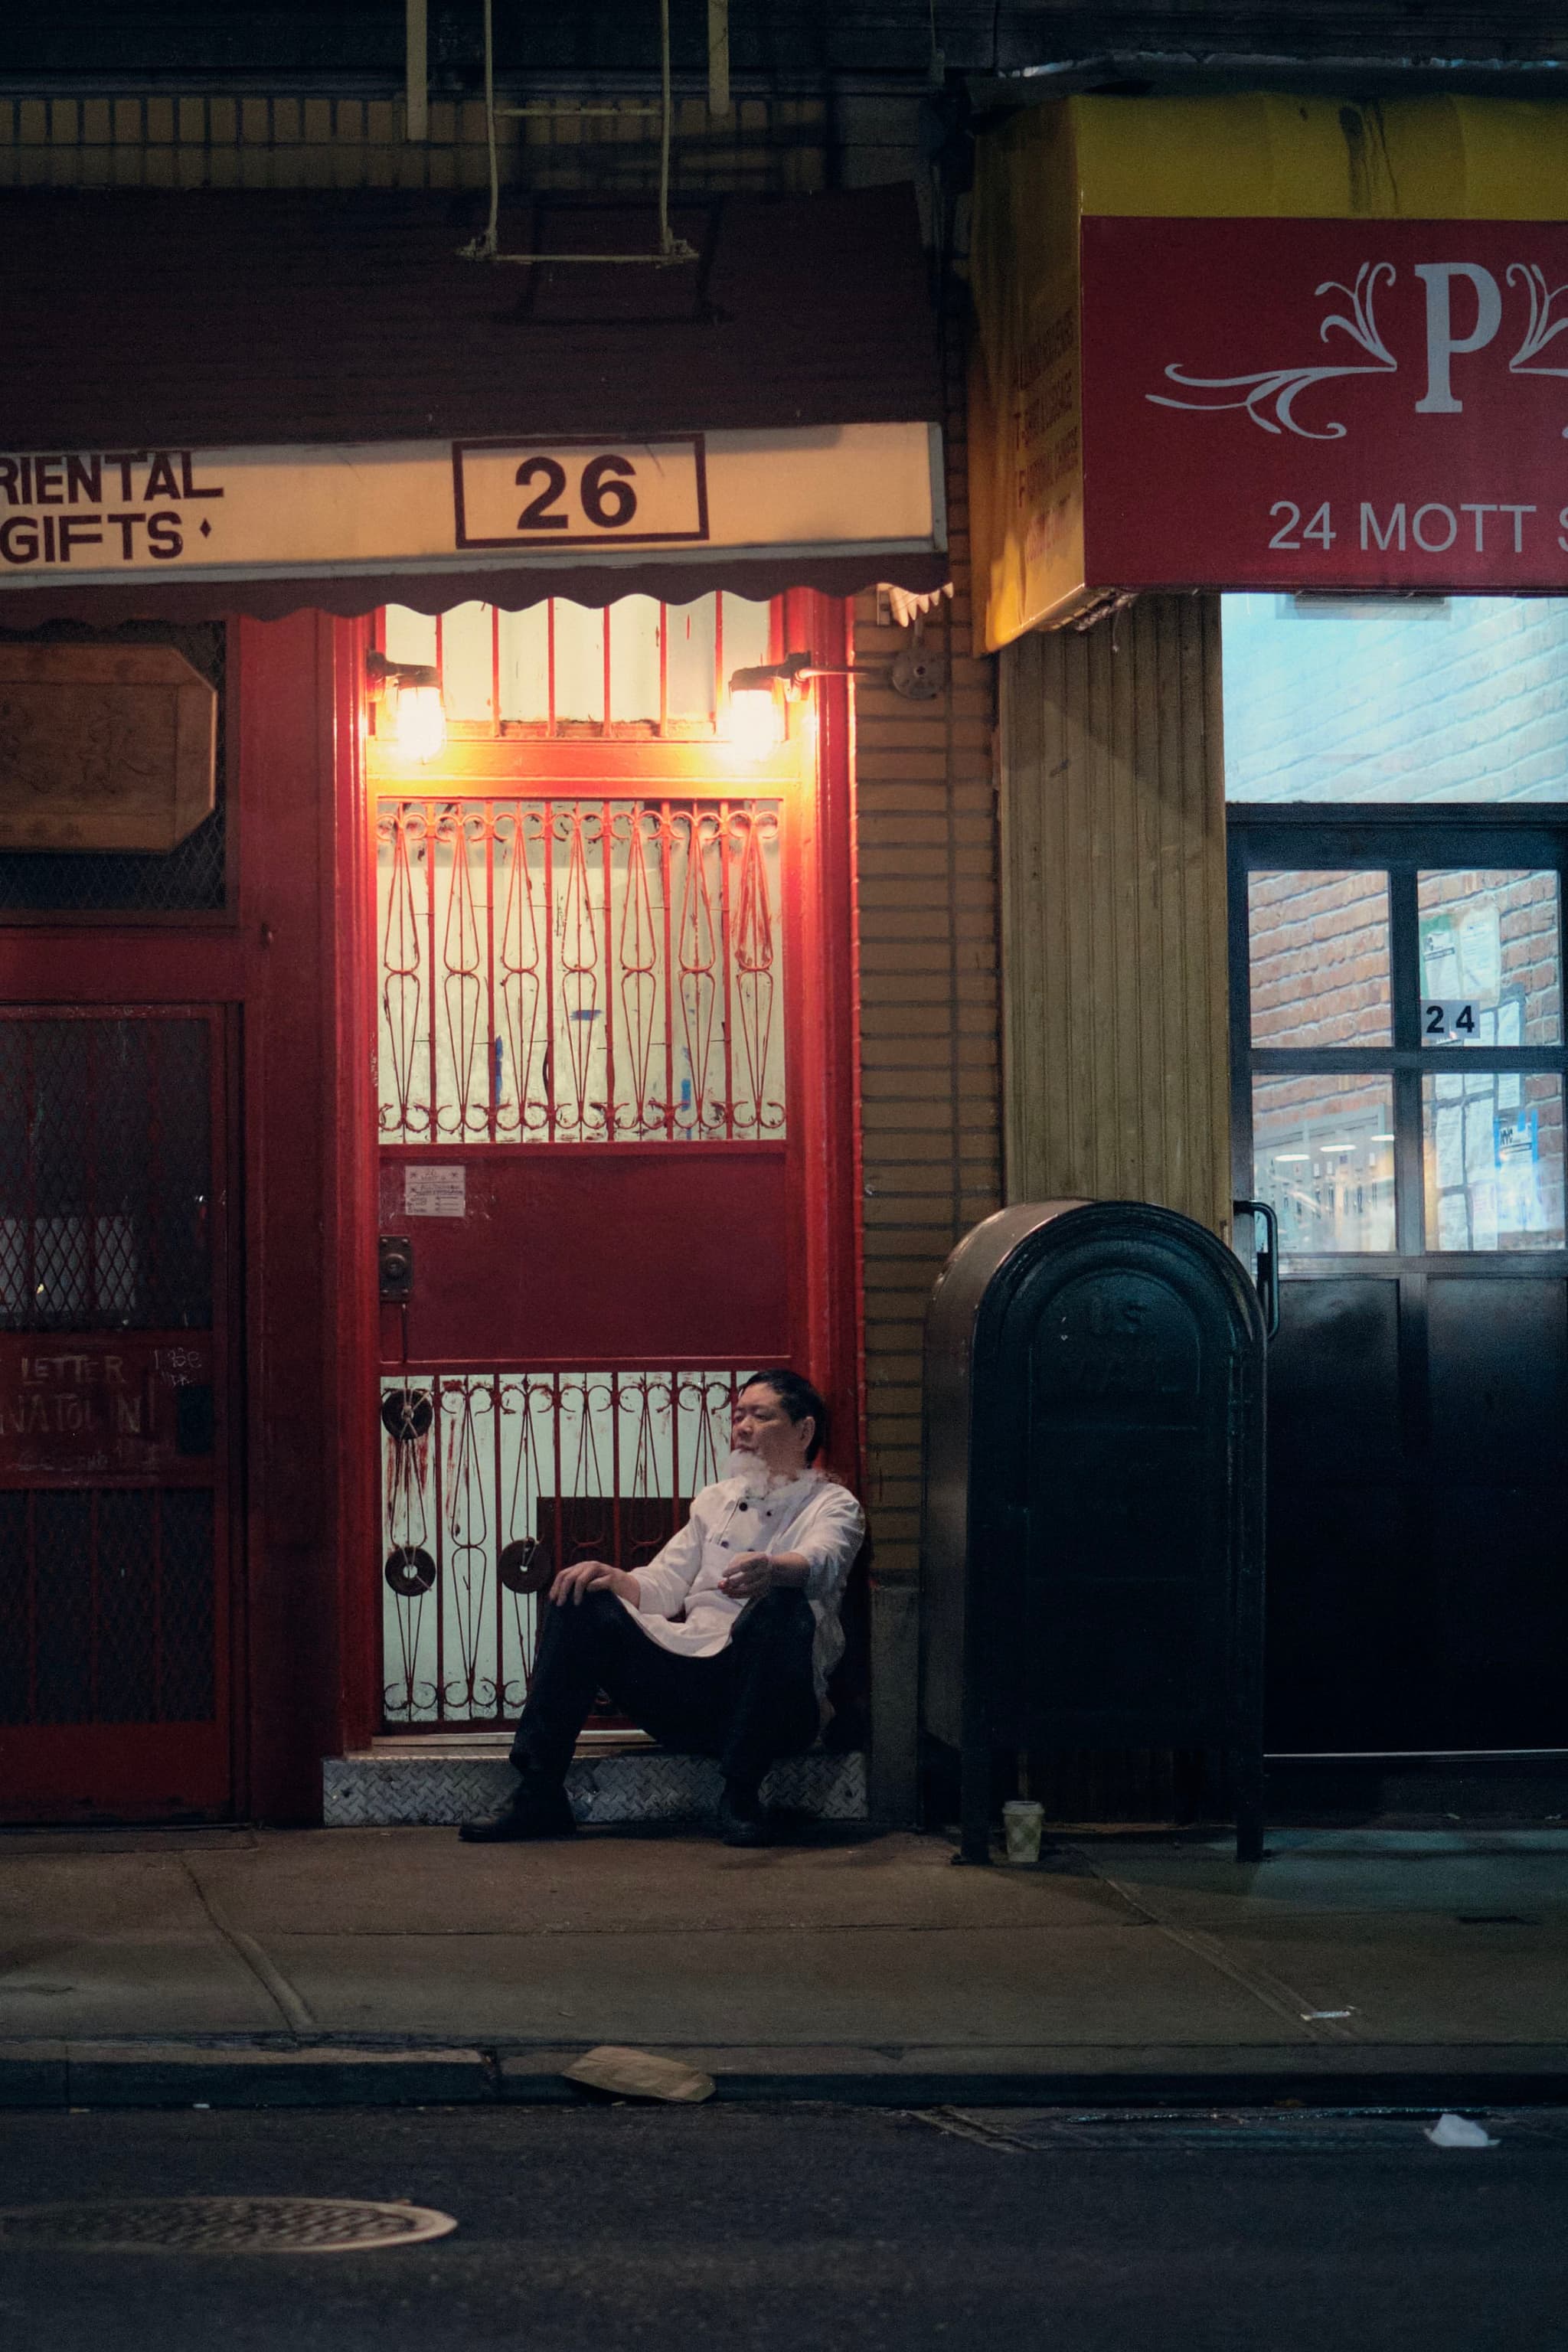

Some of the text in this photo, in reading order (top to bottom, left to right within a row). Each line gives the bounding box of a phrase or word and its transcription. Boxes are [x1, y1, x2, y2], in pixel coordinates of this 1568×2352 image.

[1414, 262, 1502, 413] P
[514, 453, 638, 530] 26
[0, 511, 184, 564] GIFTS
[1268, 500, 1337, 550] 24
[1360, 502, 1537, 553] MOTT
[1425, 1004, 1475, 1034] 24
